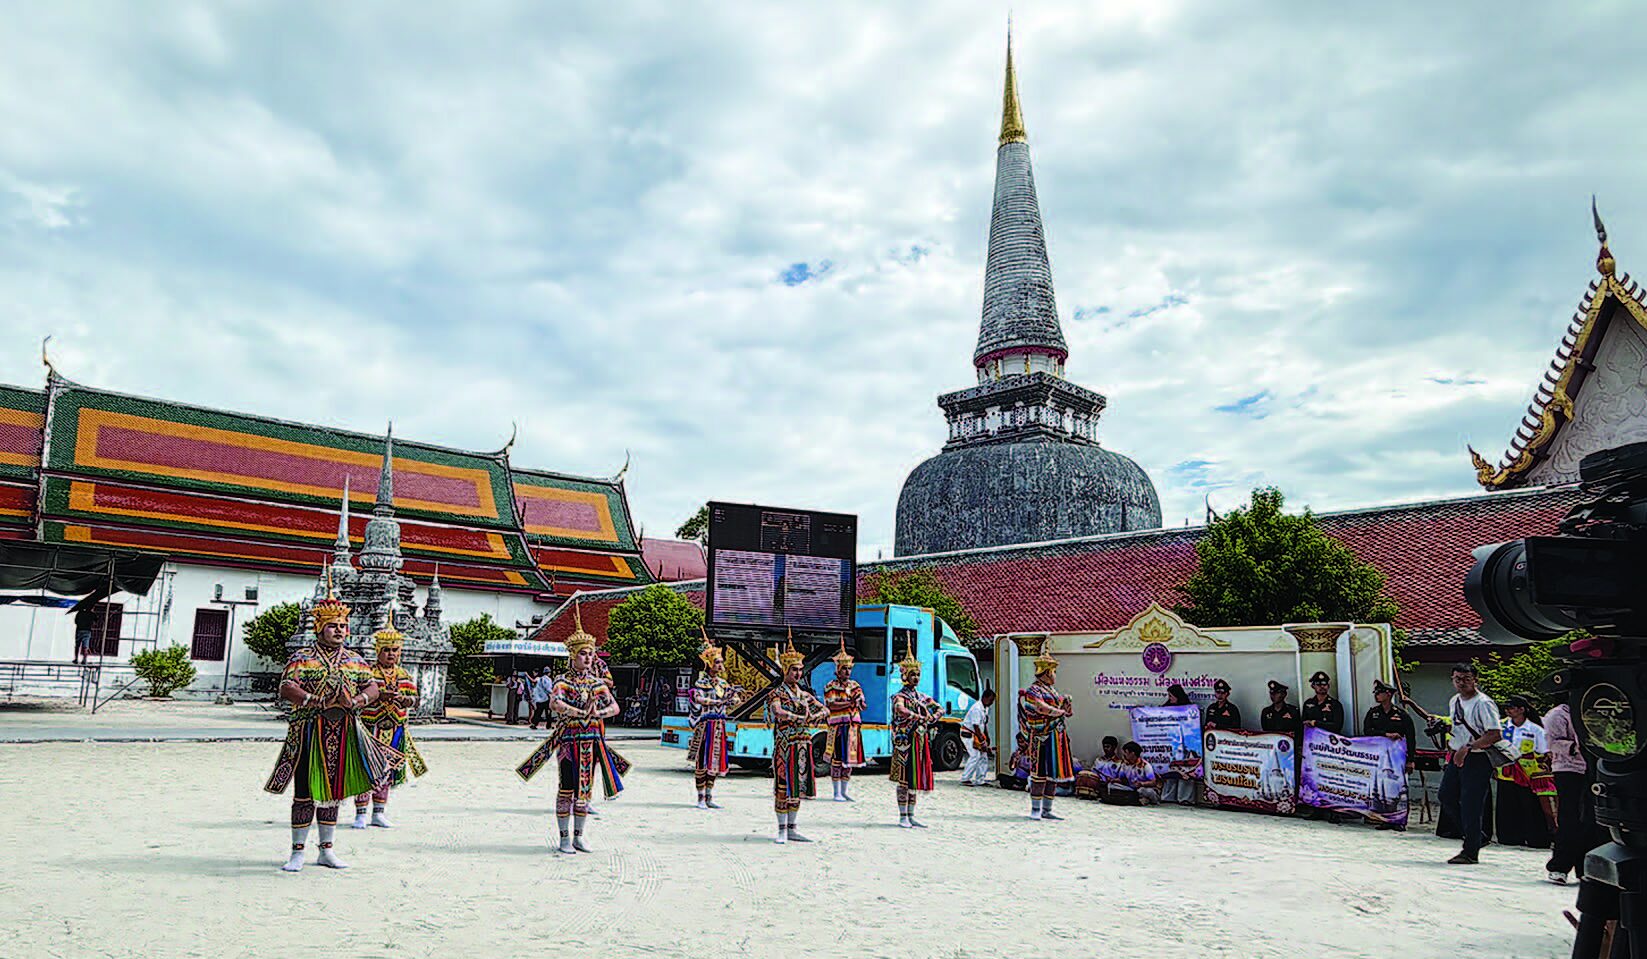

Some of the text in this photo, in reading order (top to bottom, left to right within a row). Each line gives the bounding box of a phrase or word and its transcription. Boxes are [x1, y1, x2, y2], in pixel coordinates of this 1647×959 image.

[1094, 671, 1217, 687] เมืองแห่งธรรม เมืองแห่งศรัท
